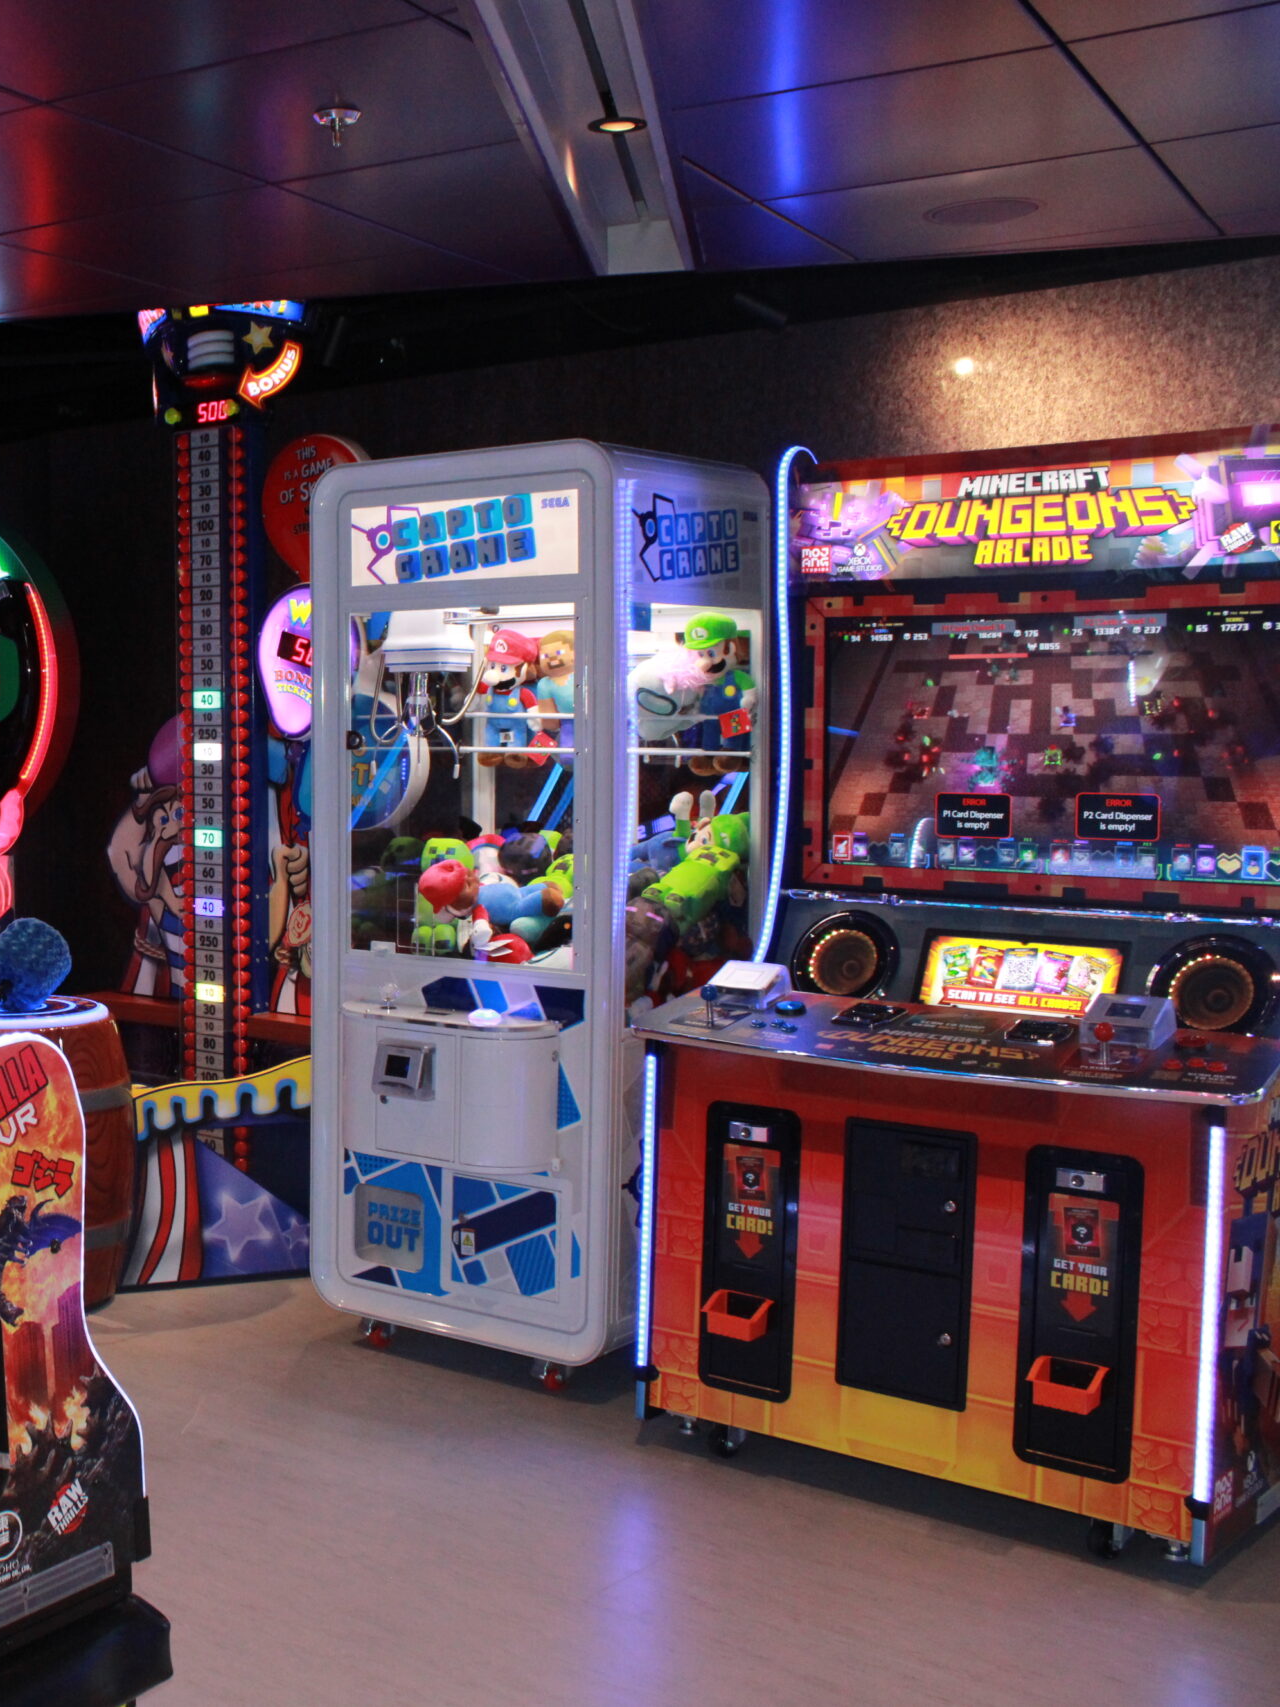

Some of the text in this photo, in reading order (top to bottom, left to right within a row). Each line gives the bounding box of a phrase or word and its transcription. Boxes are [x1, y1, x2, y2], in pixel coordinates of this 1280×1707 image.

[246, 349, 296, 397] BONUS
[200, 434, 210, 443] 10
[198, 450, 211, 461] 40
[296, 446, 317, 460] THIS
[200, 468, 210, 478] 10
[301, 458, 333, 478] GAME
[957, 467, 1110, 498] MINECRAFT
[199, 485, 211, 496] 30
[279, 488, 295, 504] OF
[201, 503, 210, 512] 10
[541, 496, 570, 508] SEGA
[894, 488, 1188, 543] DUNGEONS
[197, 520, 214, 531] 100
[392, 496, 528, 548] CAPTO
[659, 510, 737, 541] CAPTO
[1220, 522, 1253, 547] RAW
[201, 539, 210, 548] 10
[395, 530, 530, 582] CRANE
[974, 535, 1093, 566] ARCADE
[200, 555, 212, 566] 70
[661, 542, 737, 578] CRANE
[848, 556, 872, 566] XBOX
[201, 573, 211, 583] 10
[200, 589, 213, 601] 20
[201, 608, 211, 617] 10
[200, 624, 213, 636] 80
[1144, 626, 1161, 634] 237
[1220, 623, 1249, 632] 17273
[202, 643, 212, 652] 10
[200, 659, 213, 670] 50
[202, 678, 212, 687] 10
[274, 670, 312, 691] BONU
[200, 694, 213, 705] 40
[203, 713, 212, 722] 10
[198, 729, 217, 740] 250
[201, 764, 214, 775] 30
[203, 782, 213, 791] 10
[202, 798, 215, 809] 50
[962, 798, 987, 806] ERROR
[1105, 799, 1132, 807] ERROR
[203, 816, 213, 825] 10
[943, 810, 1004, 820] P1 Card Dispenser
[1083, 811, 1153, 821] P2 Card Dispenser
[964, 821, 990, 830] empty!
[1100, 822, 1136, 832] is empty!
[202, 833, 215, 844] 70
[204, 851, 214, 860] 10
[202, 867, 215, 879] 60
[204, 885, 214, 894] 10
[202, 902, 214, 913] 40
[204, 920, 214, 929] 10
[199, 936, 218, 947] 250
[204, 954, 214, 963] 10
[203, 970, 216, 981] 70
[204, 988, 214, 997] 10
[947, 988, 977, 1001] SCAN
[979, 991, 993, 1003] TO
[994, 993, 1016, 1005] SEE
[203, 1004, 216, 1015] 30
[204, 1022, 214, 1031] 10
[878, 1028, 990, 1045] MINECRAFT
[203, 1038, 216, 1050] 80
[824, 1030, 1026, 1060] DUNGEONS
[868, 1045, 957, 1060] ARCADE
[205, 1056, 215, 1065] 10
[11, 1150, 74, 1198] ゴジラ
[367, 1201, 421, 1226] PRIZE
[728, 1202, 771, 1217] GET YOUR
[726, 1214, 773, 1236] CARD!
[367, 1220, 420, 1252] OUT
[1053, 1258, 1107, 1276] GET YOUR
[1050, 1271, 1109, 1296] CARD!
[47, 1478, 85, 1526] RAW
[55, 1496, 89, 1535] THRILLS
